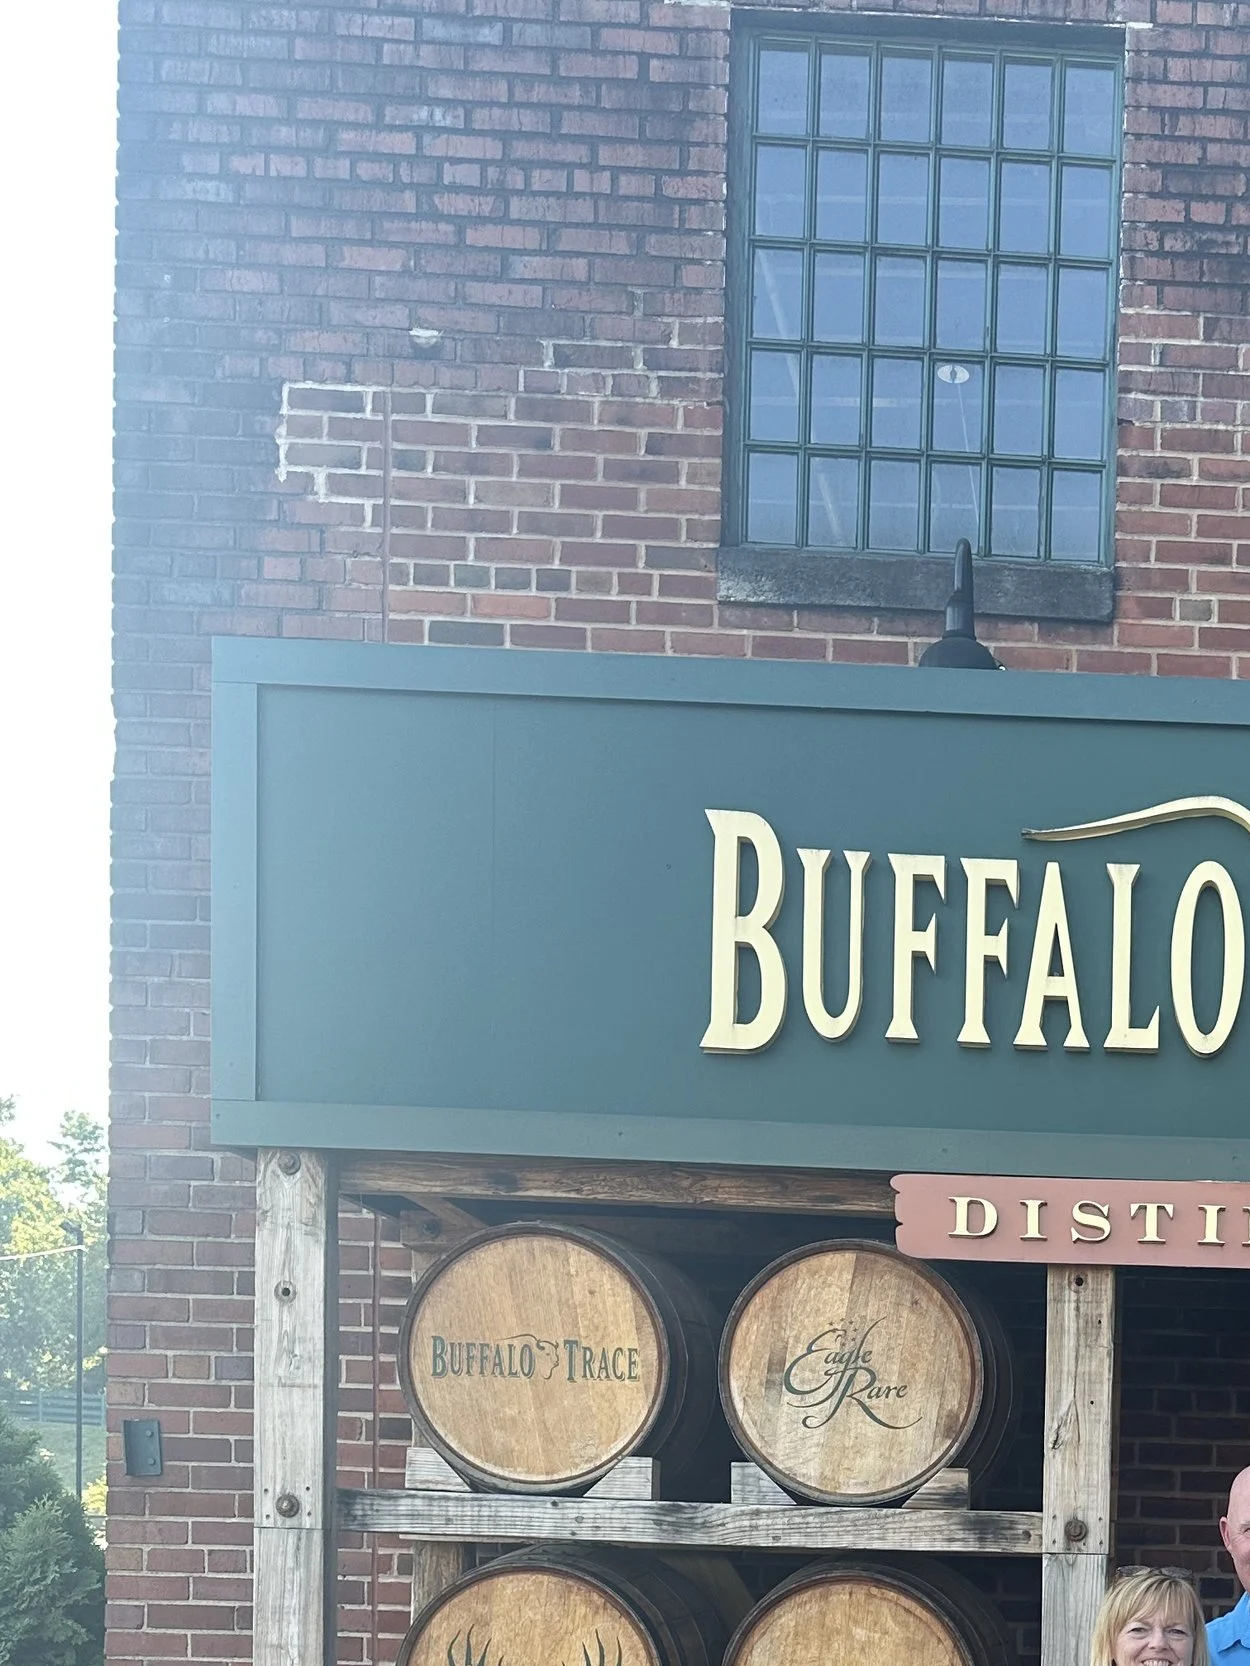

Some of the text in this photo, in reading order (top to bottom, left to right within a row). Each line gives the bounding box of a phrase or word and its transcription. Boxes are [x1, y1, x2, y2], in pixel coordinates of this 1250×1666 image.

[698, 808, 1246, 1059] BUFFALO
[431, 1335, 640, 1382] BUFFALO TRACE
[784, 1316, 887, 1408] Eagle
[802, 1367, 923, 1430] Rare
